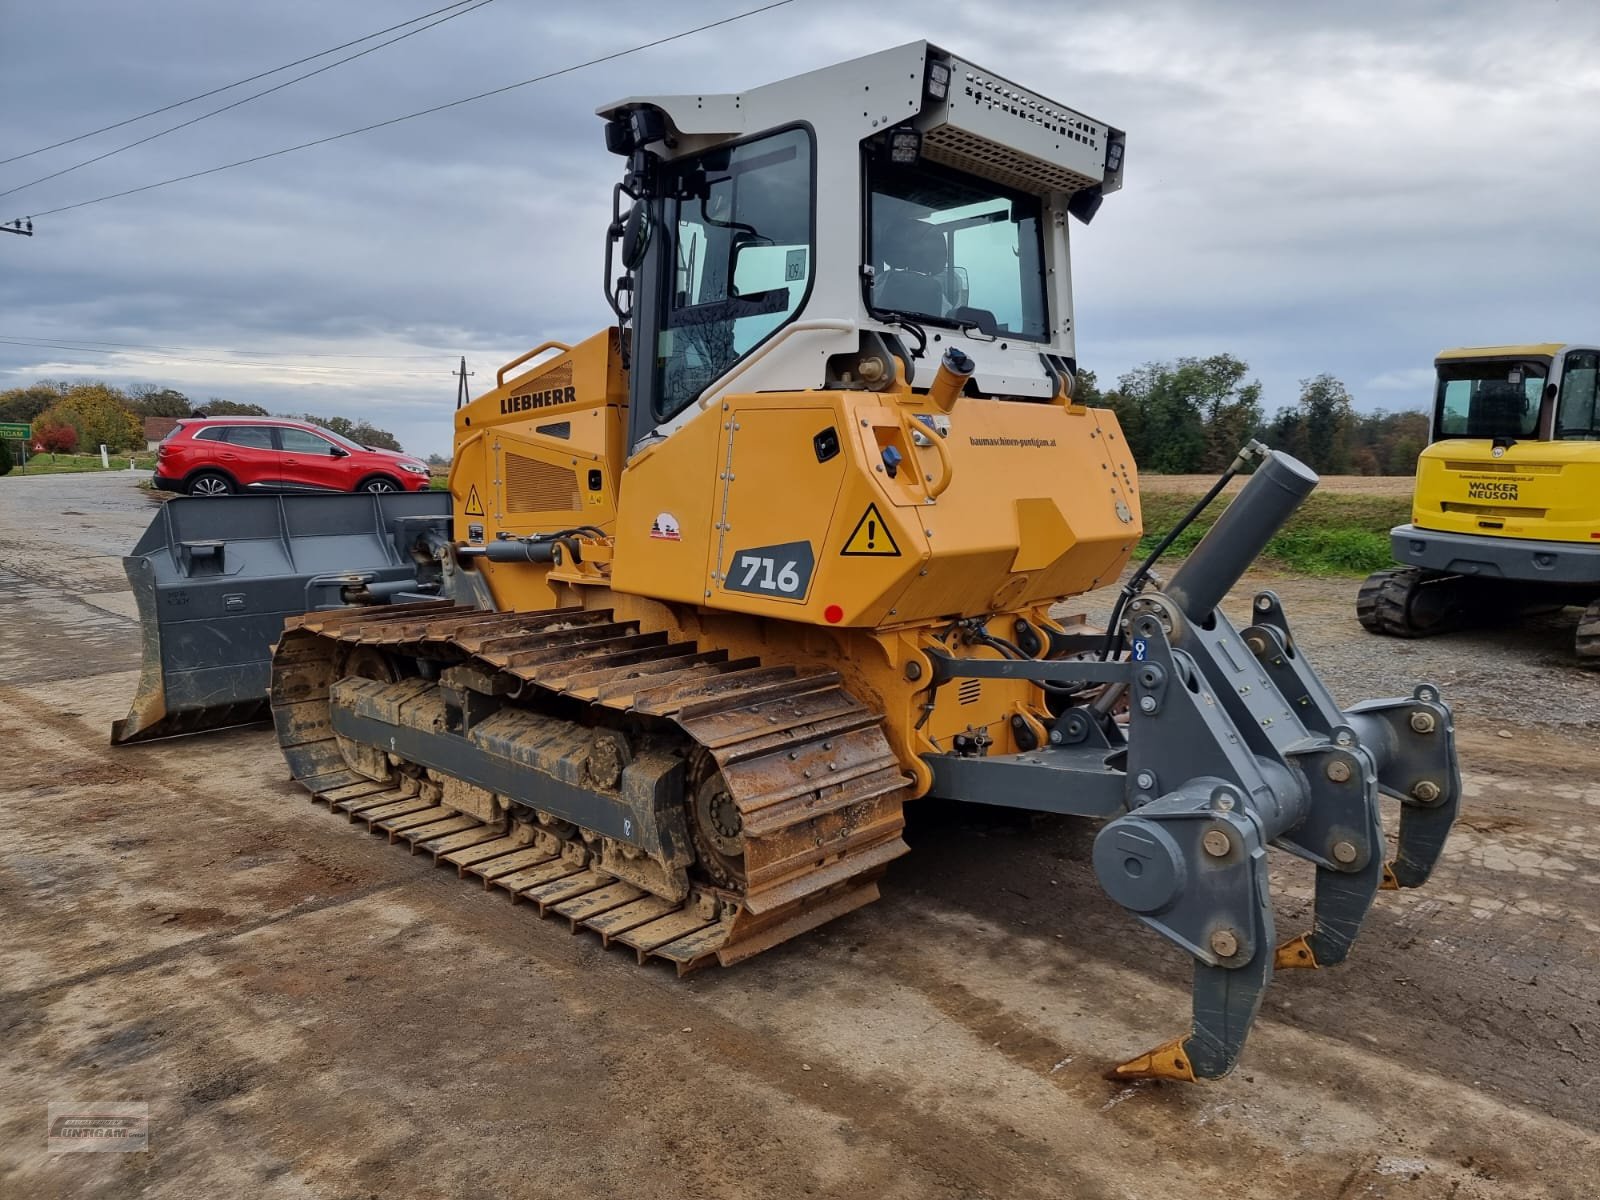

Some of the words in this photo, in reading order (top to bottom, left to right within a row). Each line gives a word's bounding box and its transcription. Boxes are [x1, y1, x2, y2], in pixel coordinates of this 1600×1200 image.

[500, 386, 576, 414] LIEBHERR
[1468, 490, 1518, 501] NEUSON
[1469, 481, 1518, 492] WACKER
[740, 555, 800, 593] 716
